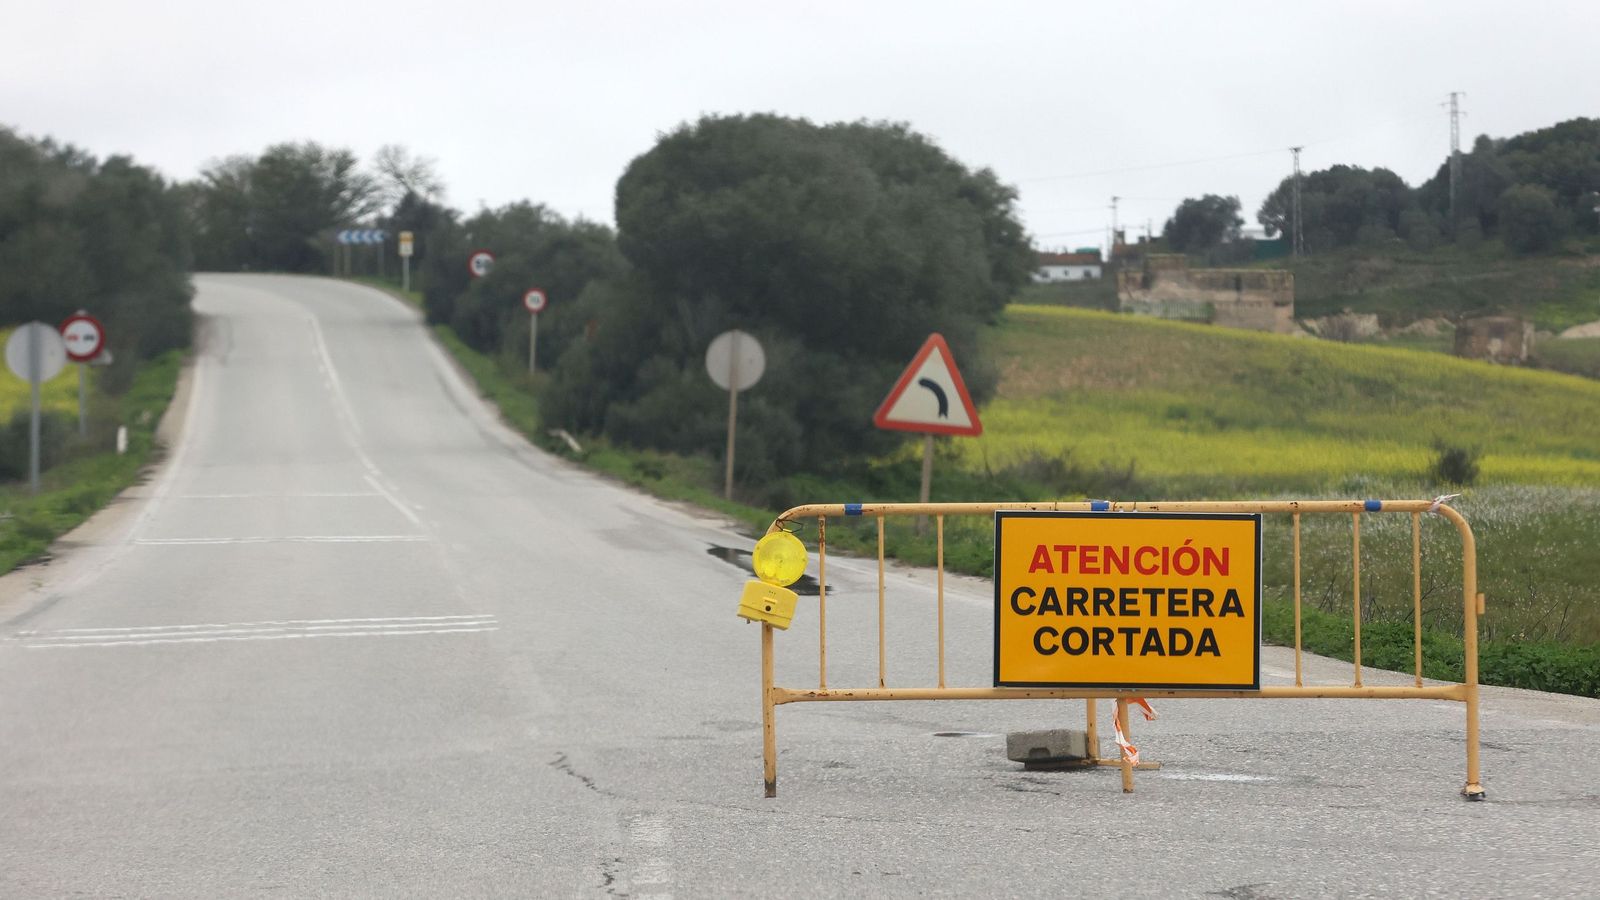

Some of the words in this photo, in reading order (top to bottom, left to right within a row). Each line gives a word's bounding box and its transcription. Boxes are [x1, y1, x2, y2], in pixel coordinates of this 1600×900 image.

[1028, 539, 1230, 576] ATENCIÓN
[1010, 586, 1245, 618] CARRETERA
[1032, 626, 1221, 657] CORTADA
